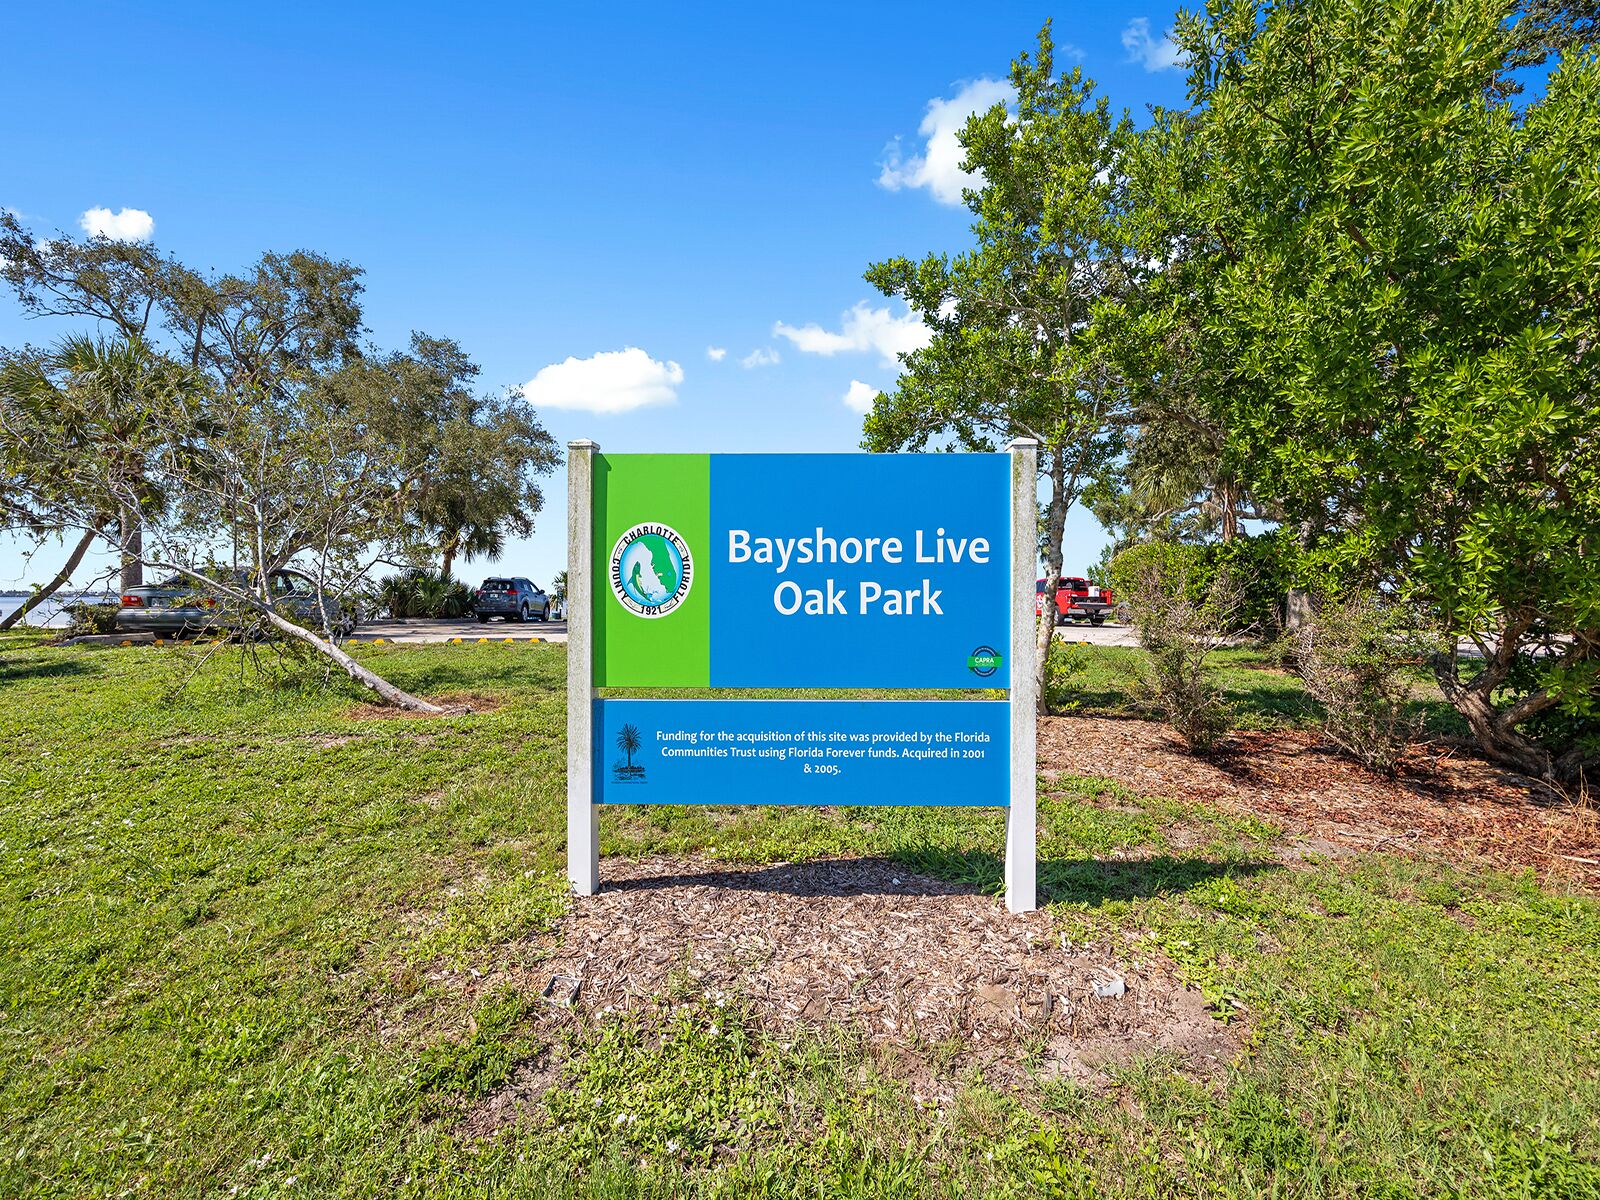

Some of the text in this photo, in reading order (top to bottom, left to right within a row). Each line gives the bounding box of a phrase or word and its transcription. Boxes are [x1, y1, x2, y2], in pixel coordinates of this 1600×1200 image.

[623, 525, 681, 545] CHARLOTTE
[728, 527, 990, 571] Bayshore Live
[612, 558, 628, 600] COUNTY
[673, 555, 691, 602] FLORIDA
[773, 578, 944, 616] Oak Park
[641, 606, 662, 615] 1921
[657, 731, 990, 745] Funding for the acquisition of this site was provided by the Florida
[662, 747, 985, 760] Communities Trust using Florida Forever funds. Acquired in 2001
[804, 764, 841, 775] & 2005.
